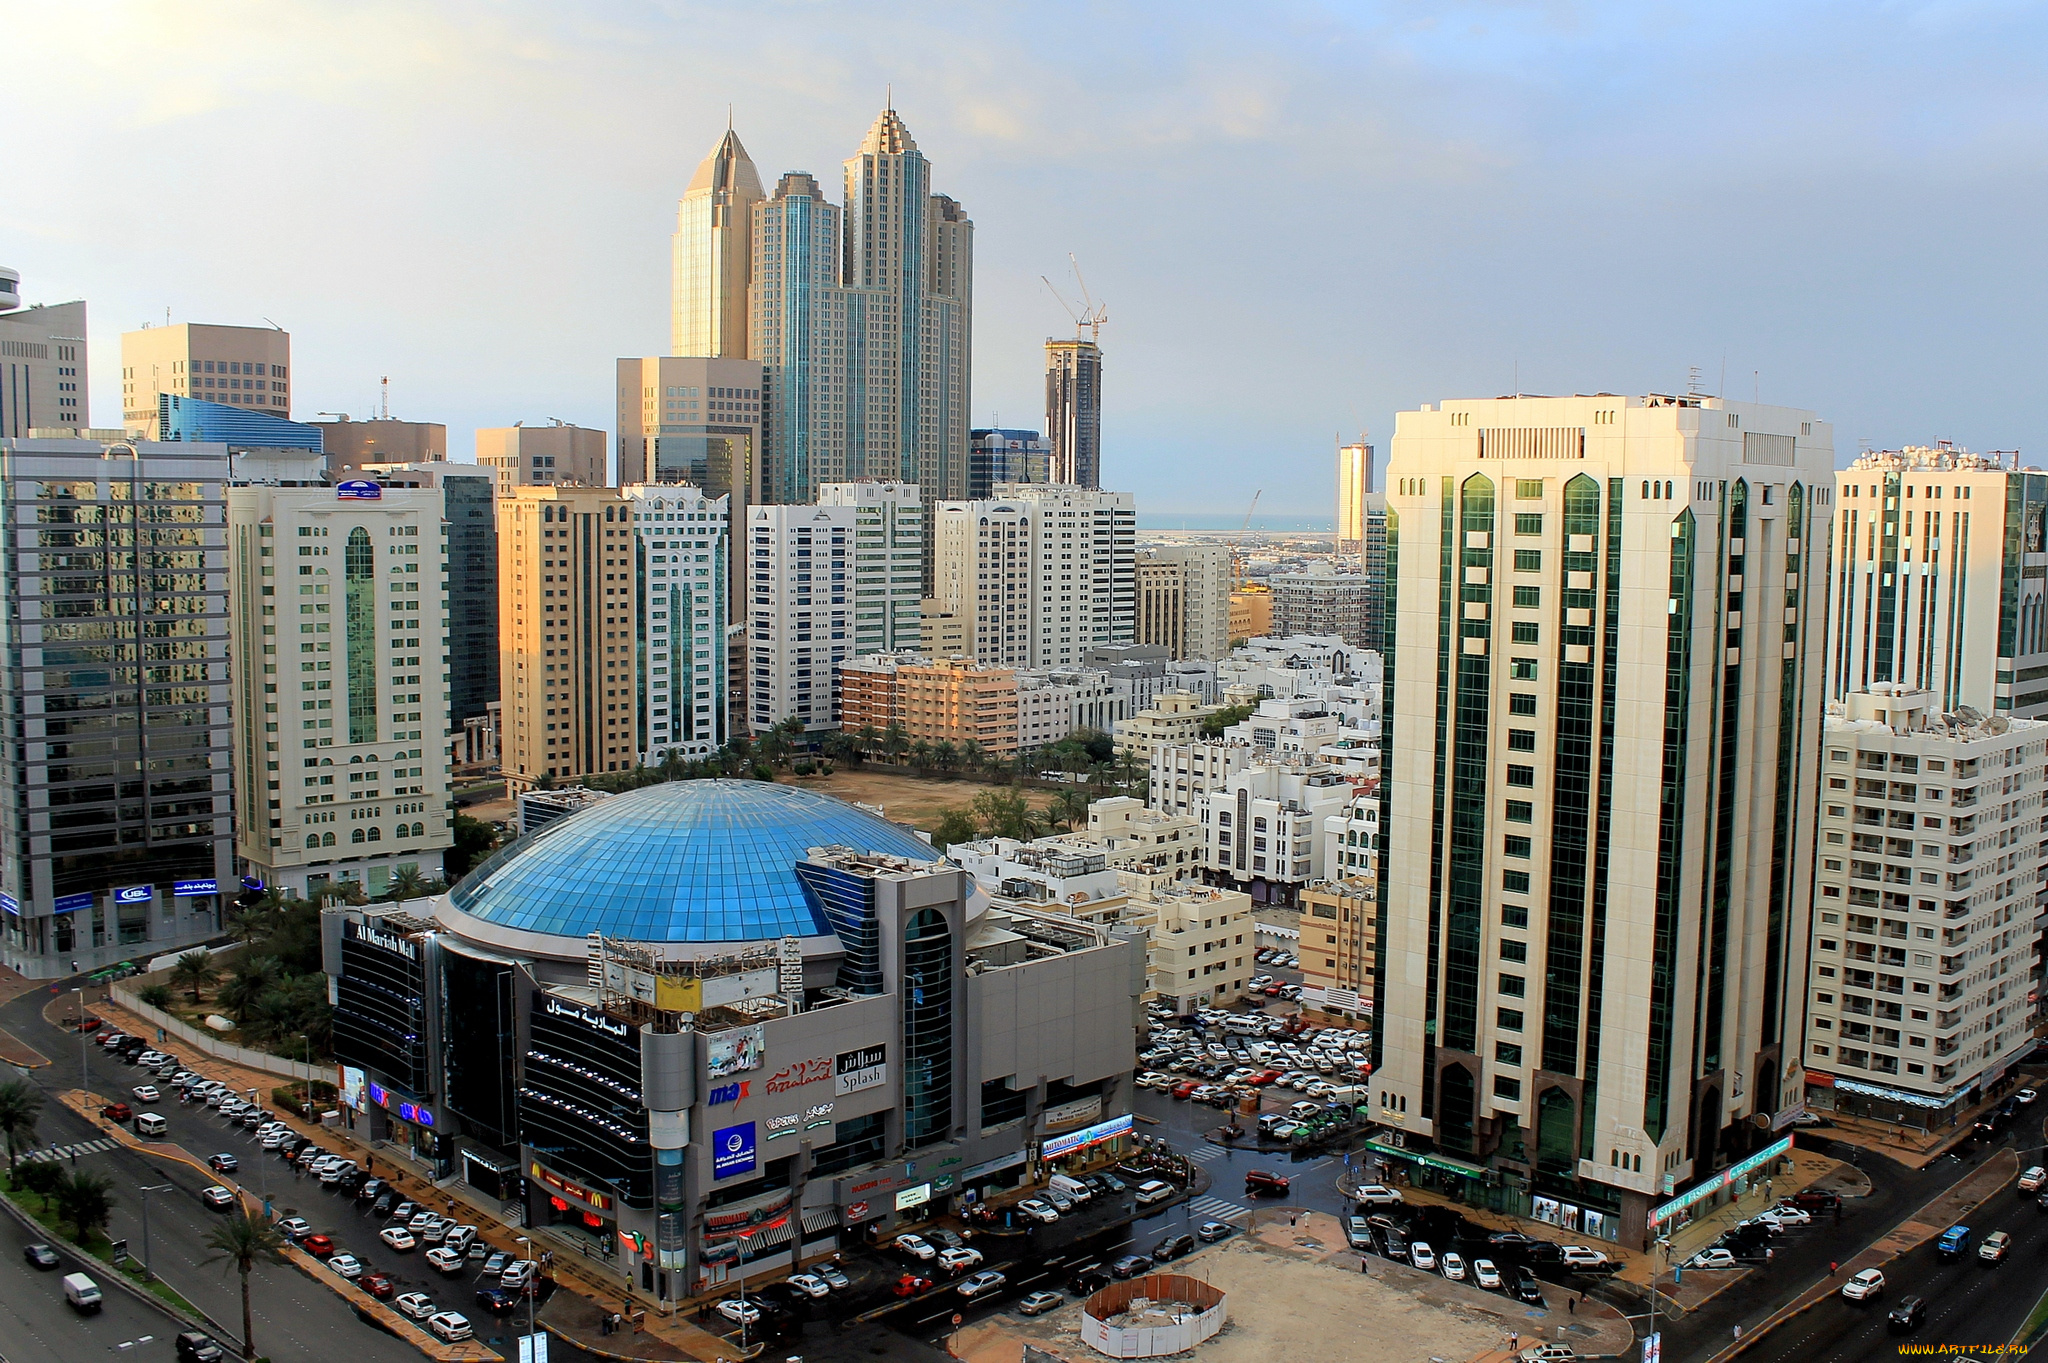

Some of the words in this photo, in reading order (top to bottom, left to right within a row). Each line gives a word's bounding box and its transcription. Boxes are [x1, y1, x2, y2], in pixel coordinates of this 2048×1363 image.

[126, 889, 148, 898] UBL
[357, 924, 366, 940] Al
[367, 928, 397, 952] Mariah
[398, 938, 415, 960] Mall
[546, 999, 579, 1019] مول
[840, 1050, 882, 1073] سبلاش
[766, 1068, 833, 1095] Pizzaland
[842, 1069, 880, 1092] Splash
[370, 1081, 391, 1108] max
[708, 1080, 751, 1113] max
[1045, 1134, 1080, 1151] AUTOMATIC
[851, 1180, 878, 1193] PARKING
[1657, 1195, 1686, 1220] SAFARI
[1687, 1174, 1723, 1202] FASHIONS
[708, 1211, 749, 1227] AUTOMATIC
